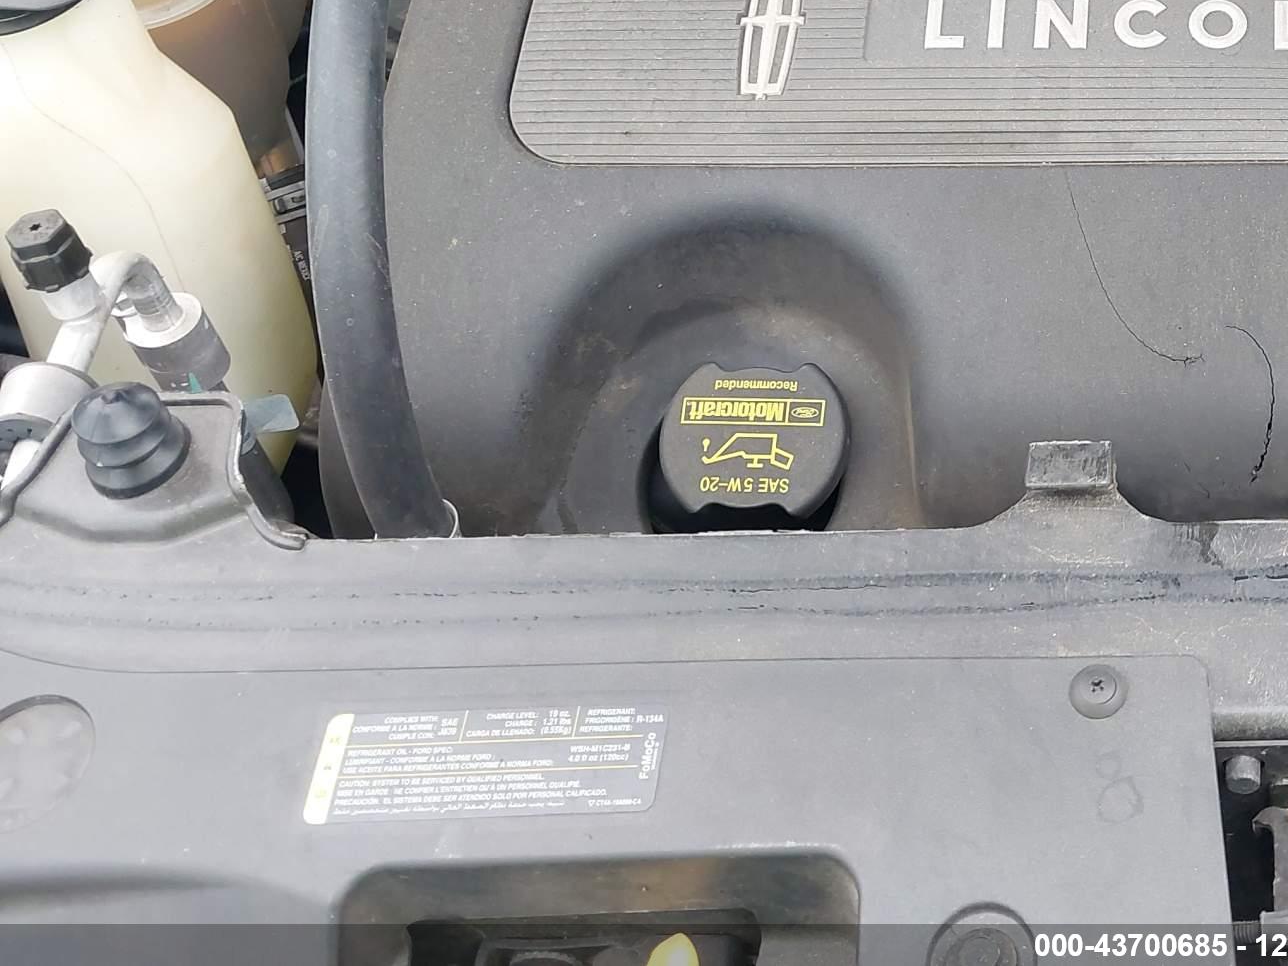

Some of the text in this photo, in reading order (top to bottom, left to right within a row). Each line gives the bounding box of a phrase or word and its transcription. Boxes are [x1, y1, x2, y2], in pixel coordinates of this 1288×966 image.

[714, 378, 798, 392] Recommended
[700, 476, 790, 494] SAE 5W-20
[638, 732, 657, 780] FoMoCo
